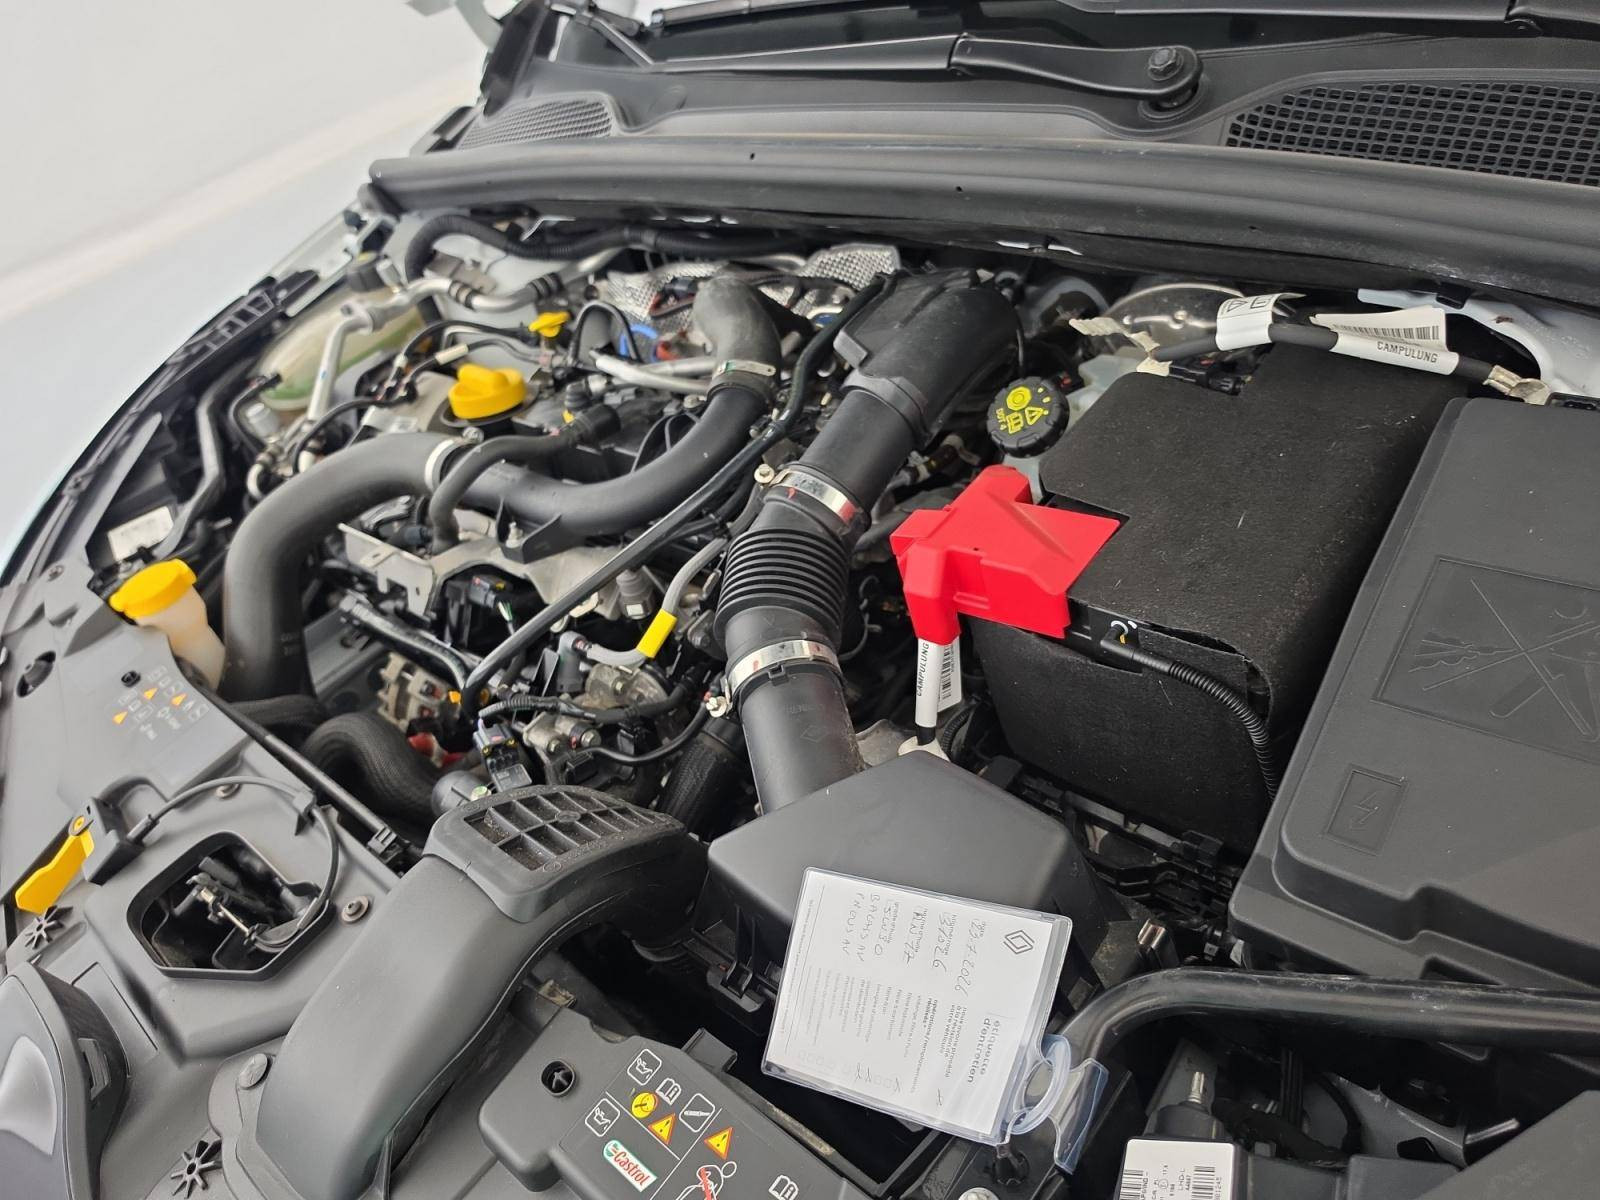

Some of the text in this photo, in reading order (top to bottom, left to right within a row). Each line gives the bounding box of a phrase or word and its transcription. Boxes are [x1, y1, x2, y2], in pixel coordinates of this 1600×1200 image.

[1377, 341, 1438, 363] CAMPULUNG
[916, 642, 930, 697] CAMPULUNG
[967, 1018, 991, 1082] d'entretien
[613, 1151, 650, 1186] Castrol
